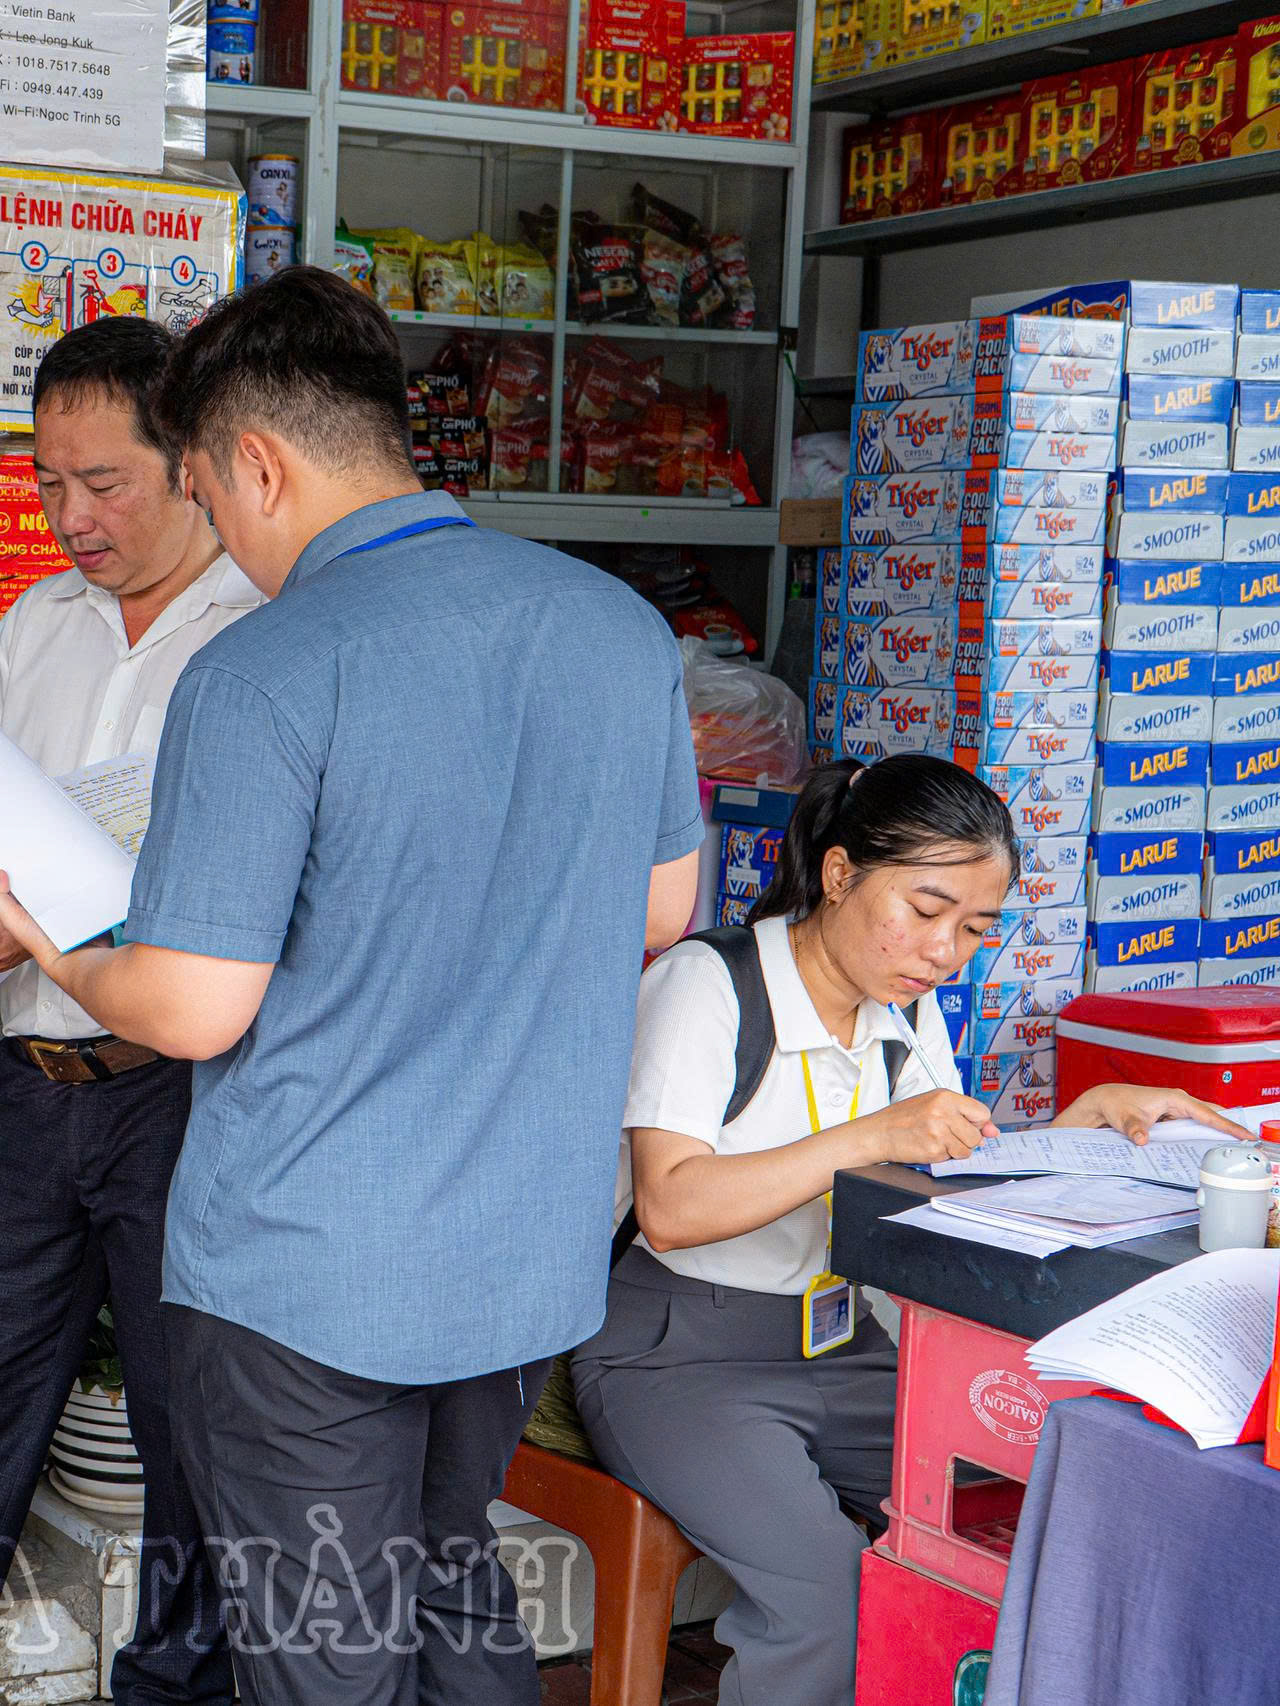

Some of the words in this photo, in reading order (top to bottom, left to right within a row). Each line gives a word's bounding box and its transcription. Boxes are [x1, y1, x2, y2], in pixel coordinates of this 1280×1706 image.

[12, 5, 43, 19] Vietin
[47, 9, 76, 23] Bank
[15, 30, 36, 43] Lee
[39, 33, 68, 49] Jong
[72, 37, 94, 50] Kuk
[16, 55, 111, 77] 1018.7517.5648
[22, 81, 104, 101] 0949.447.439
[74, 110, 101, 125] Trinh
[105, 114, 122, 127] 5G
[0, 191, 62, 231] LỆNH
[71, 200, 135, 236] CHỮA
[143, 208, 203, 243] CHÁY
[30, 248, 41, 266] 2
[106, 254, 118, 271] 3
[178, 262, 190, 279] 4
[1157, 290, 1216, 325] LARUE
[15, 344, 33, 359] CÚP
[901, 331, 954, 372] Tiger
[977, 337, 1008, 356] COOL
[1103, 334, 1115, 346] 24
[1152, 337, 1210, 367] SMOOTH
[13, 365, 32, 378] DAO
[974, 359, 1007, 377] PACK
[2, 383, 19, 395] NƠI
[1154, 382, 1213, 416] LARUE
[1098, 408, 1110, 420] 24
[895, 408, 949, 448] Tiger
[972, 417, 1004, 436] COOL
[970, 438, 1003, 456] PACK
[1148, 431, 1207, 461] SMOOTH
[887, 480, 940, 519] Tiger
[963, 492, 992, 509] COOL
[1087, 483, 1099, 495] 24
[1149, 474, 1208, 508] LARUE
[19, 511, 50, 535] NỘ
[961, 509, 989, 527] PACK
[1143, 522, 1201, 552] SMOOTH
[884, 552, 937, 591] Tiger
[1083, 557, 1095, 569] 24
[960, 567, 988, 585] COOL
[1144, 566, 1202, 601] LARUE
[958, 585, 987, 602] PACK
[1031, 585, 1074, 613] Tiger
[1081, 631, 1094, 642] 24
[1138, 613, 1195, 643] SMOOTH
[879, 625, 933, 664] Tiger
[957, 642, 986, 659] COOL
[955, 659, 985, 677] PACK
[1028, 659, 1070, 687] Tiger
[1131, 657, 1191, 693] LARUE
[1235, 661, 1280, 693] LARU
[879, 696, 931, 734] Tiger
[955, 714, 983, 732] COOL
[1133, 704, 1192, 735] SMOOTH
[952, 731, 981, 749] PACK
[1026, 732, 1069, 760] Tiger
[1129, 747, 1189, 782] LARUE
[1236, 748, 1280, 781] LARU
[1020, 805, 1063, 833] Tiger
[1124, 794, 1182, 825] SMOOTH
[1120, 837, 1179, 874] LARUE
[1121, 881, 1179, 913] SMOOTH
[1118, 925, 1176, 963] LARUE
[950, 995, 962, 1006] 24
[983, 1392, 1039, 1426] SAIGON
